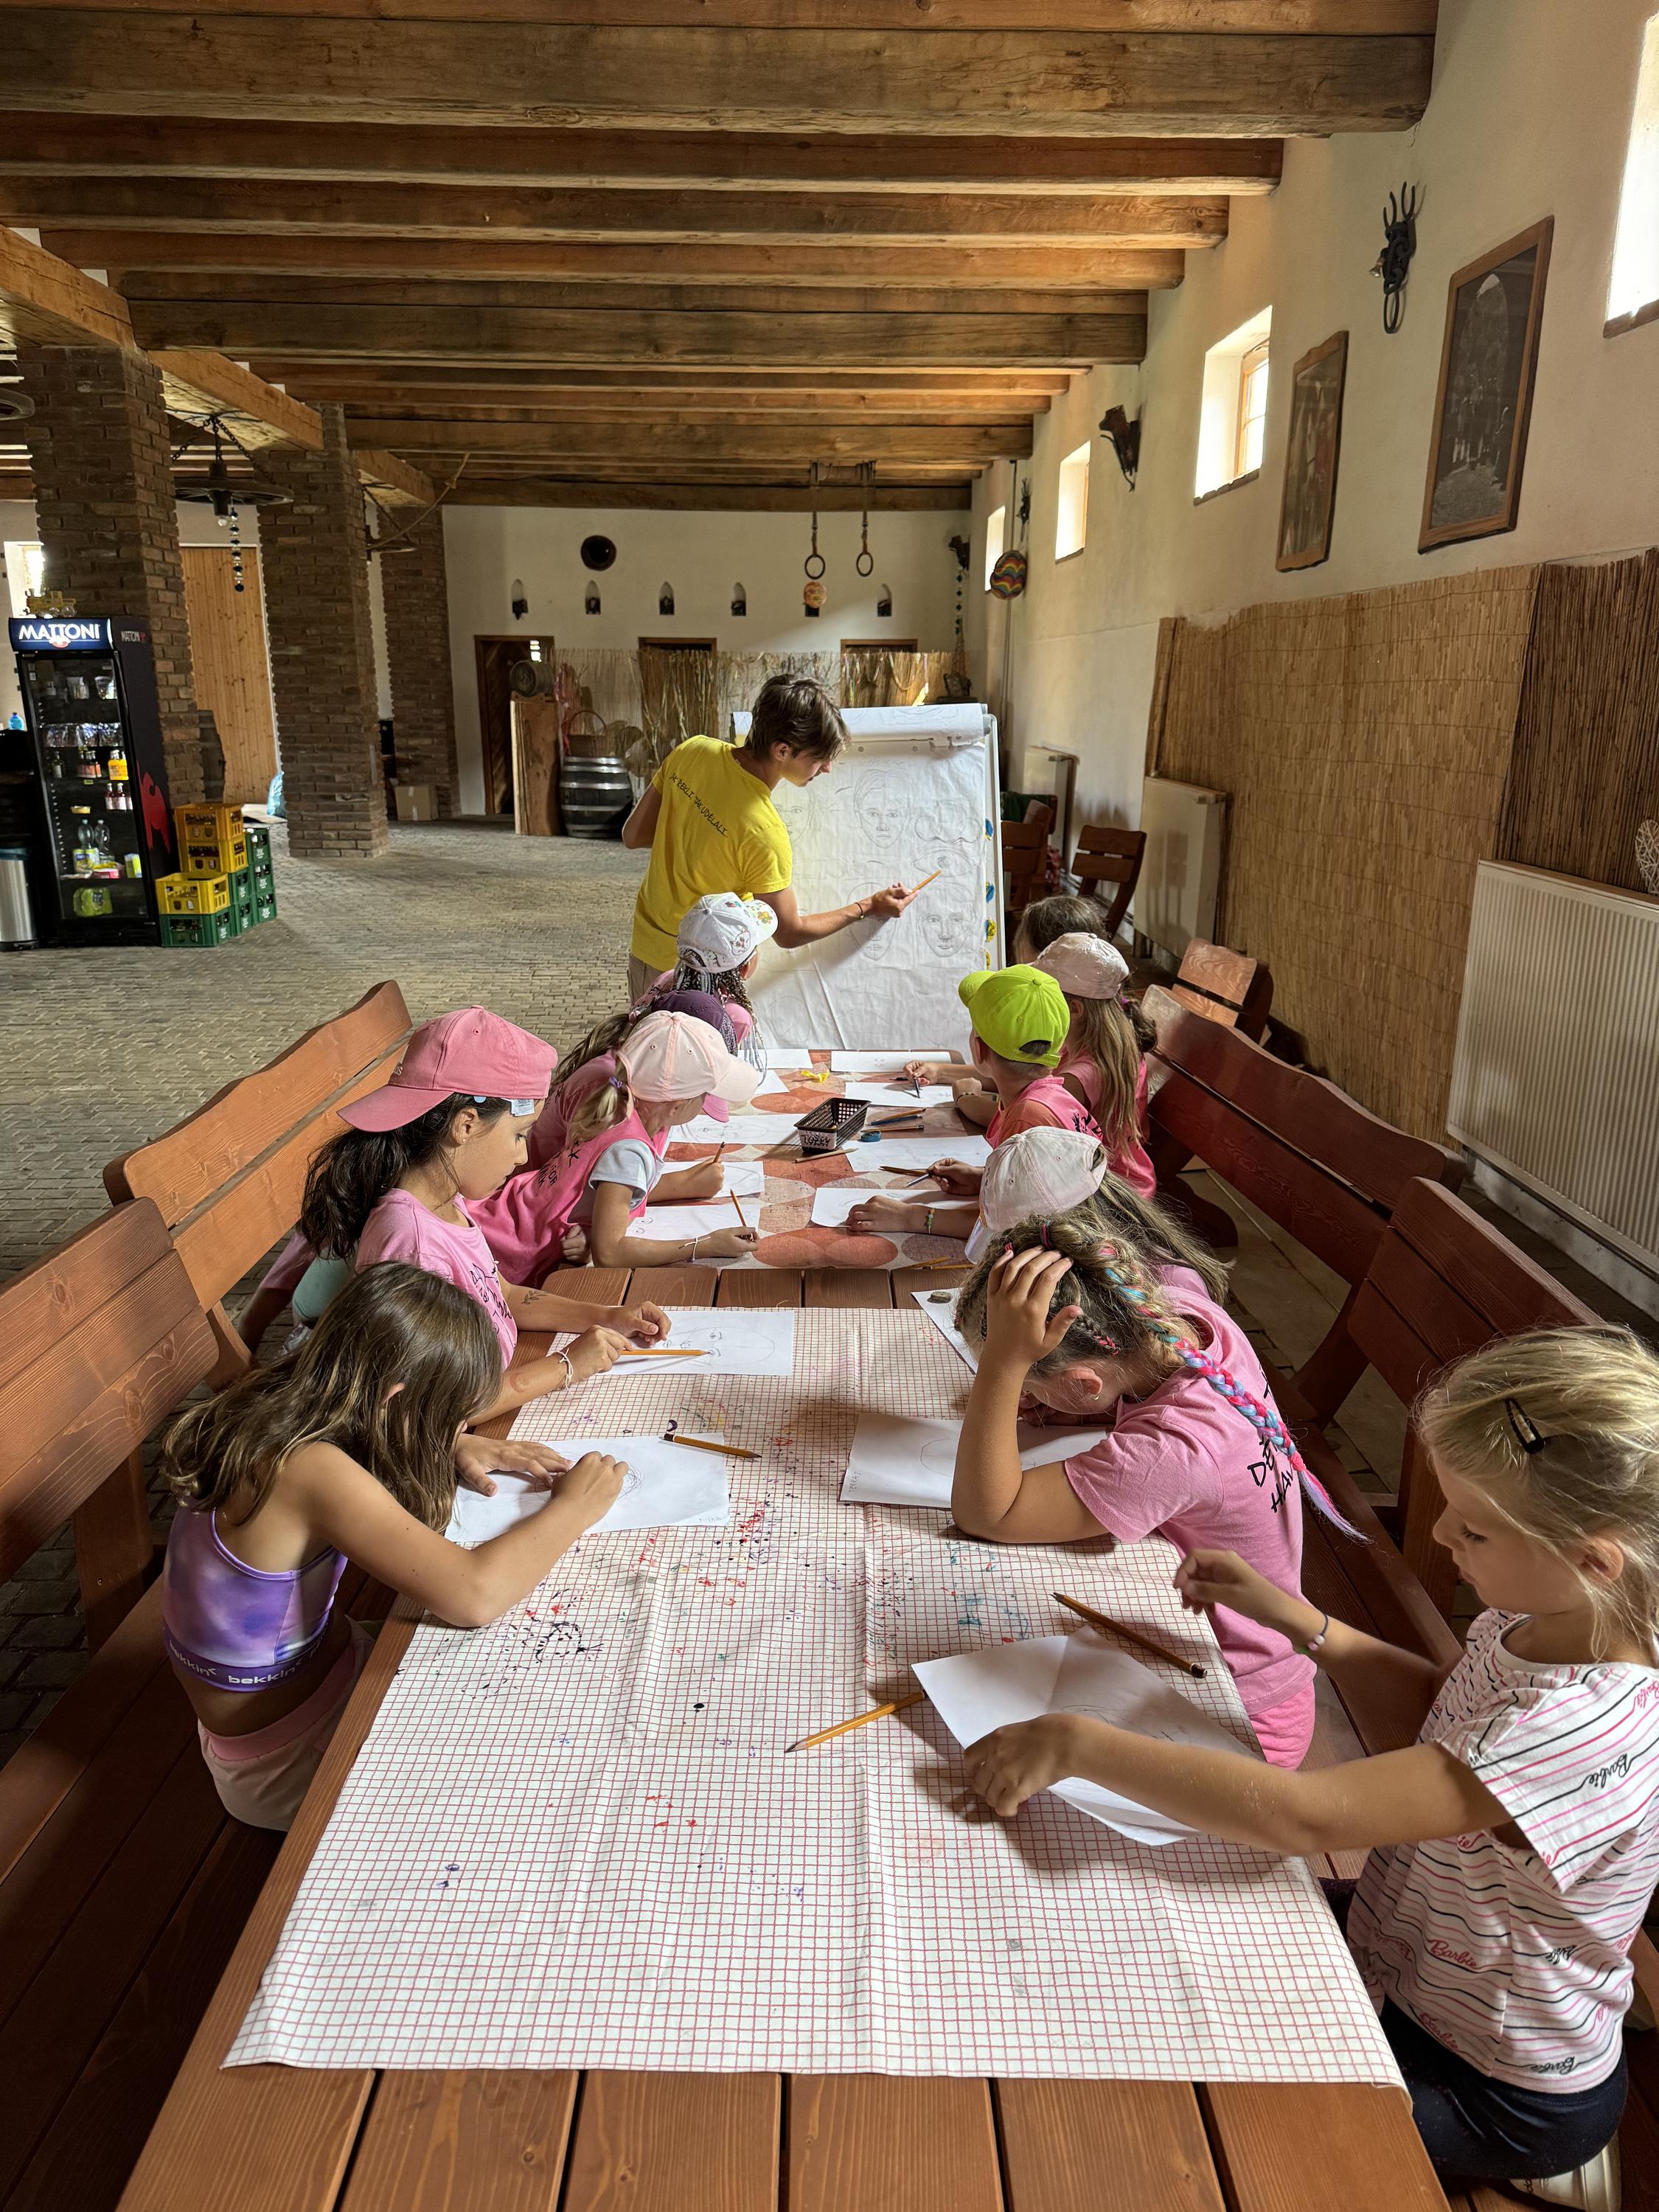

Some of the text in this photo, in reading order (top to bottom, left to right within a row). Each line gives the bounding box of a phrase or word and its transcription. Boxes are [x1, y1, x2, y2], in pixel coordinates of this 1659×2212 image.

[18, 623, 100, 640] MATTONI
[1587, 1753, 1628, 1789] Barbie
[1429, 1939, 1477, 1968] Barbie
